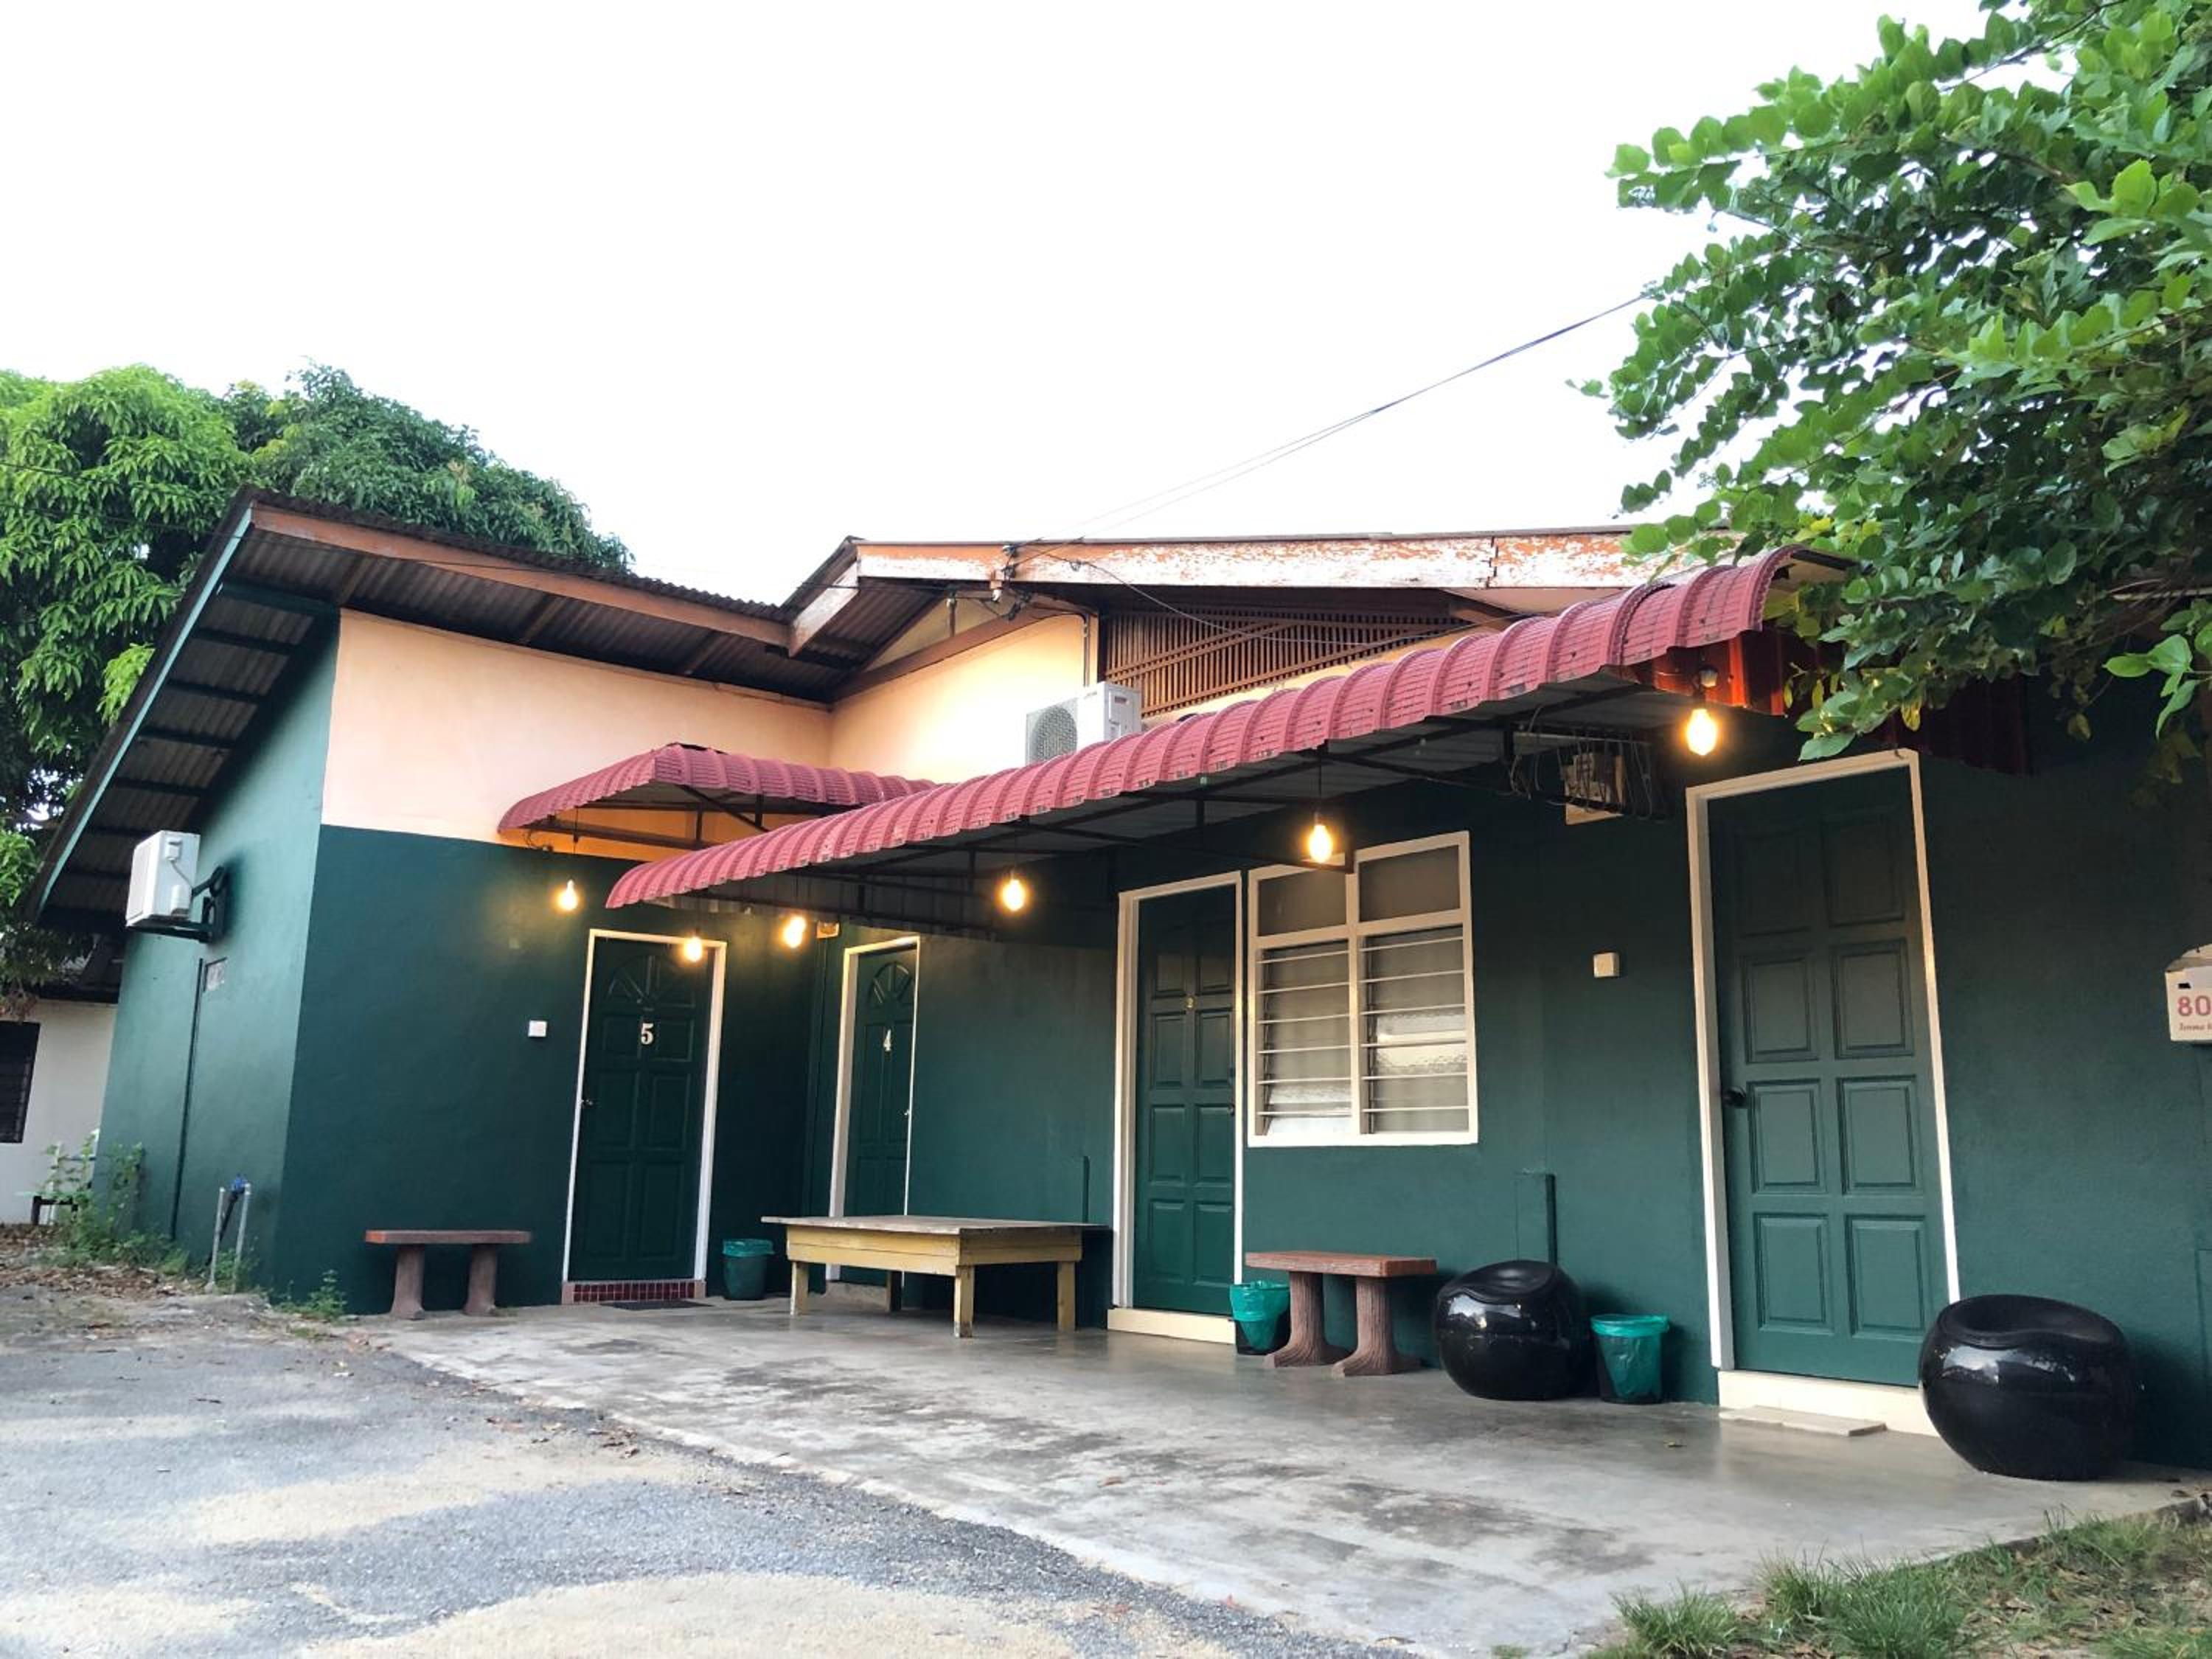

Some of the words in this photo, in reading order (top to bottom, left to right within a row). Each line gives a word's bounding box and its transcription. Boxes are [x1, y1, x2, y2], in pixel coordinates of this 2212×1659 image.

[2177, 995, 2212, 1017] 80
[641, 1023, 654, 1045] 5
[883, 1029, 891, 1051] 4
